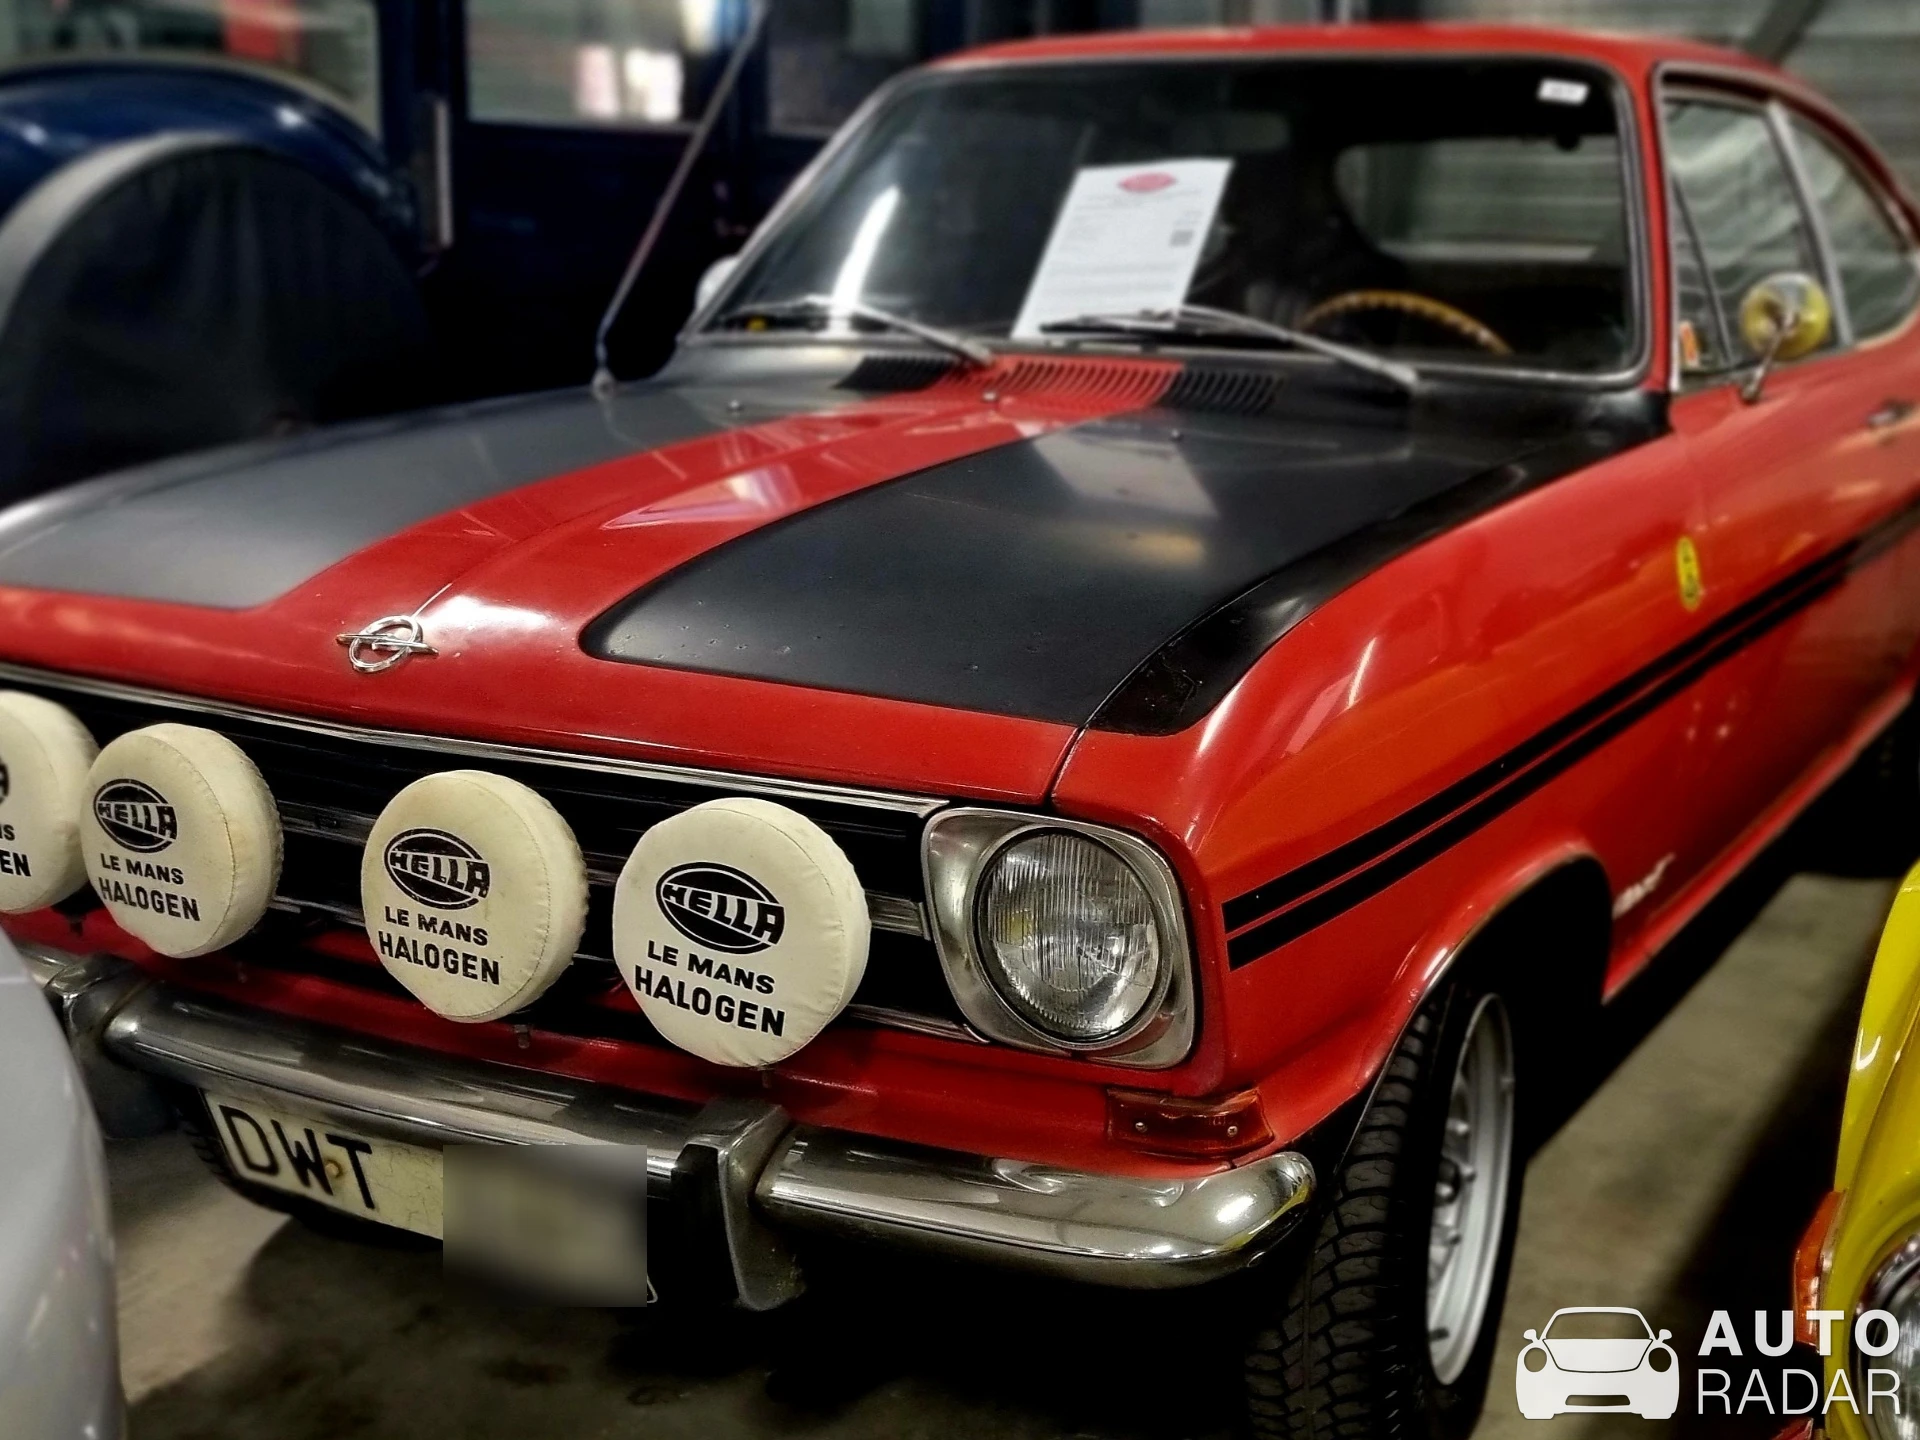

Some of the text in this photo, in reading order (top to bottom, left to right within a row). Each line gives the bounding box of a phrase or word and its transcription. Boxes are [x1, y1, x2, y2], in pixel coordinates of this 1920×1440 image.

[97, 801, 178, 842] HELLA
[100, 853, 184, 884] LE MANS
[388, 850, 490, 899] HELLA
[98, 876, 200, 921] HALOGEN
[661, 883, 785, 945] HELLA
[385, 906, 488, 946] LE MANS
[378, 931, 500, 985] HALOGEN
[648, 940, 775, 994] LE MANS
[634, 965, 785, 1037] HALOGEN
[219, 1105, 375, 1210] DWT
